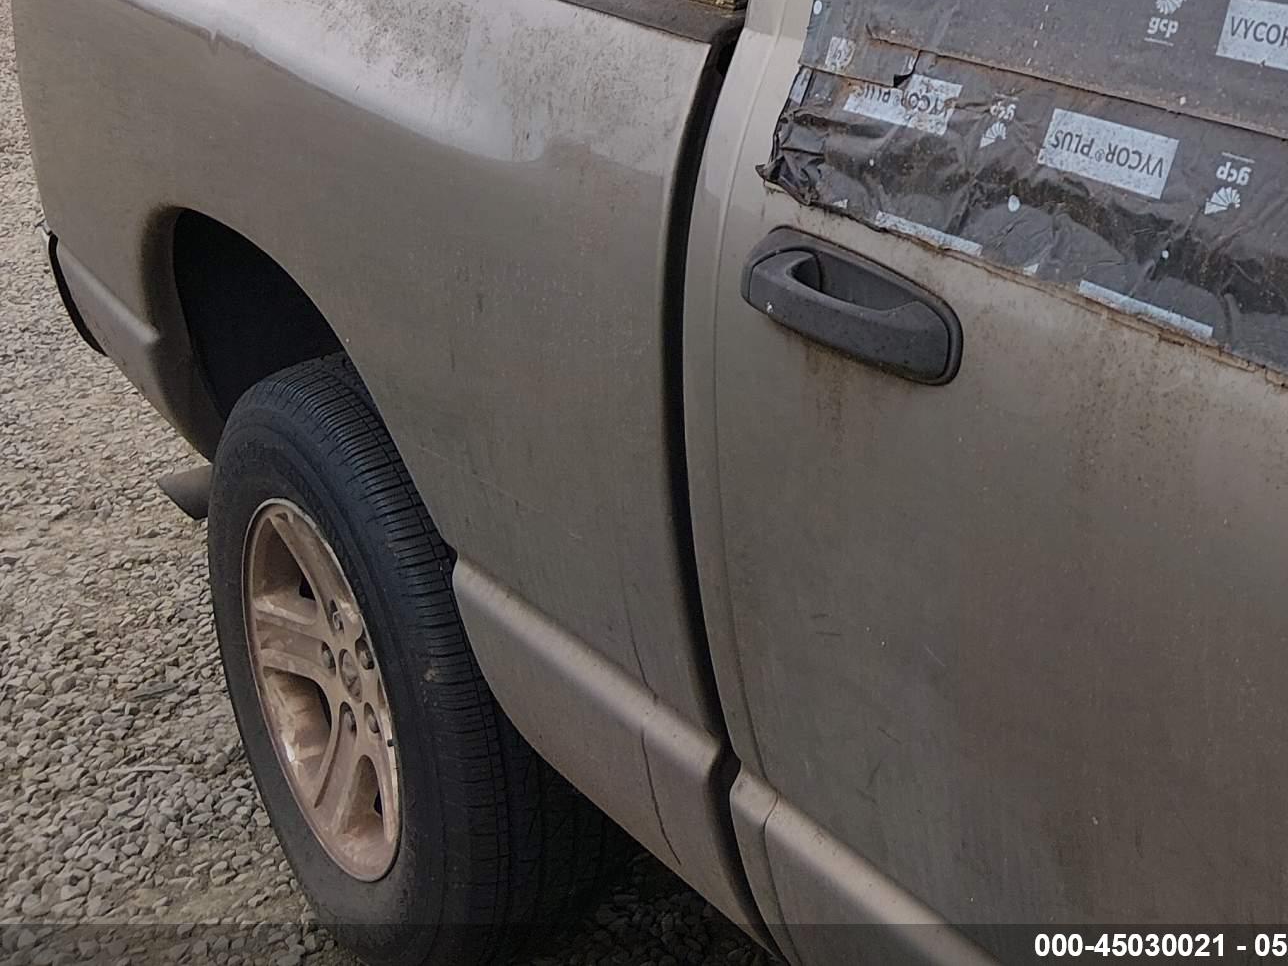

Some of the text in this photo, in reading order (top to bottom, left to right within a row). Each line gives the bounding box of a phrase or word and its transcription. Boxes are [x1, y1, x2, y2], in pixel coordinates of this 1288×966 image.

[1147, 15, 1180, 37] gcp
[1051, 130, 1094, 157] PLUS
[1215, 161, 1253, 186] gcp
